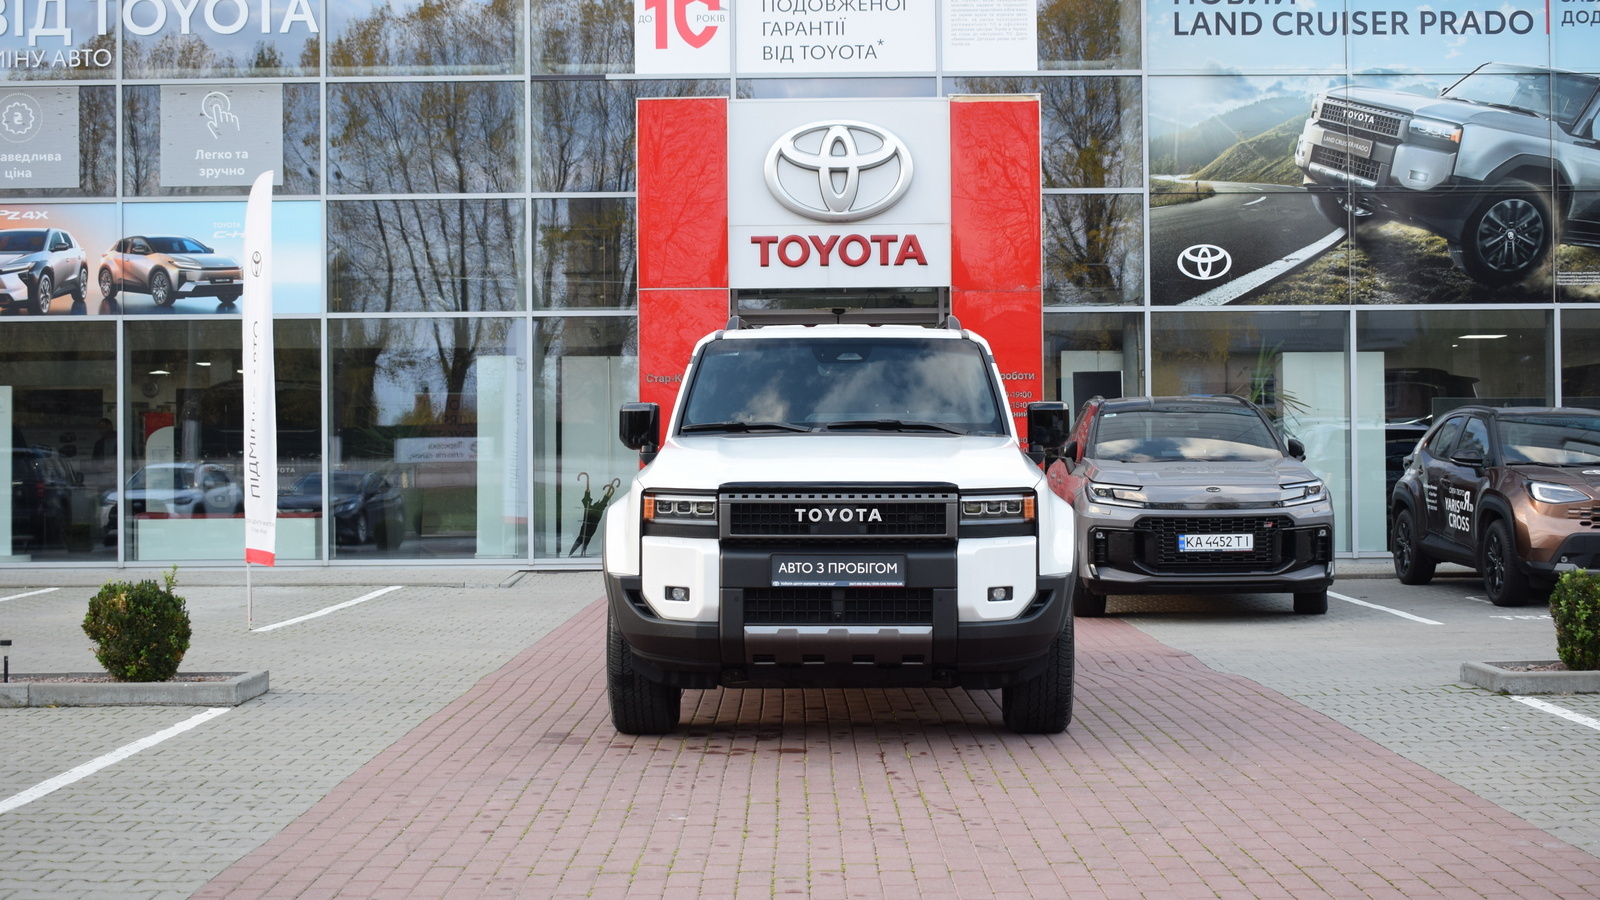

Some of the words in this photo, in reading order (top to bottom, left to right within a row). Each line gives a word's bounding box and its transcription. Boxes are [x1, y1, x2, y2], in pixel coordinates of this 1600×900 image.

[0, 0, 72, 46] ІД
[88, 0, 320, 36] TOYOTA
[638, 15, 653, 24] ДО
[696, 14, 725, 23] РОКІВ
[1174, 11, 1262, 36] LAND
[1272, 10, 1410, 36] CRUISER
[1420, 9, 1534, 35] PRADO
[762, 17, 846, 36] ГАРАНТІЇ
[0, 50, 46, 68] ІНУ
[52, 48, 112, 68] АВТО
[762, 45, 794, 63] ВІД
[1342, 110, 1374, 124] TOYOTA
[1323, 135, 1336, 144] LAND
[194, 149, 233, 160] Легко
[235, 150, 249, 160] та
[4, 167, 32, 180] ціна
[199, 167, 246, 179] зручно
[750, 234, 928, 268] TOYOTA
[646, 374, 685, 385] Стар-К
[1444, 496, 1460, 513] YARIS
[794, 508, 882, 523] TOYOTA
[1448, 512, 1470, 532] CROSS
[1186, 536, 1203, 548] KA
[1205, 535, 1233, 548] 4452
[778, 562, 813, 574] АВТО
[816, 562, 825, 574] З
[828, 562, 898, 574] ПРОБІГОМ
